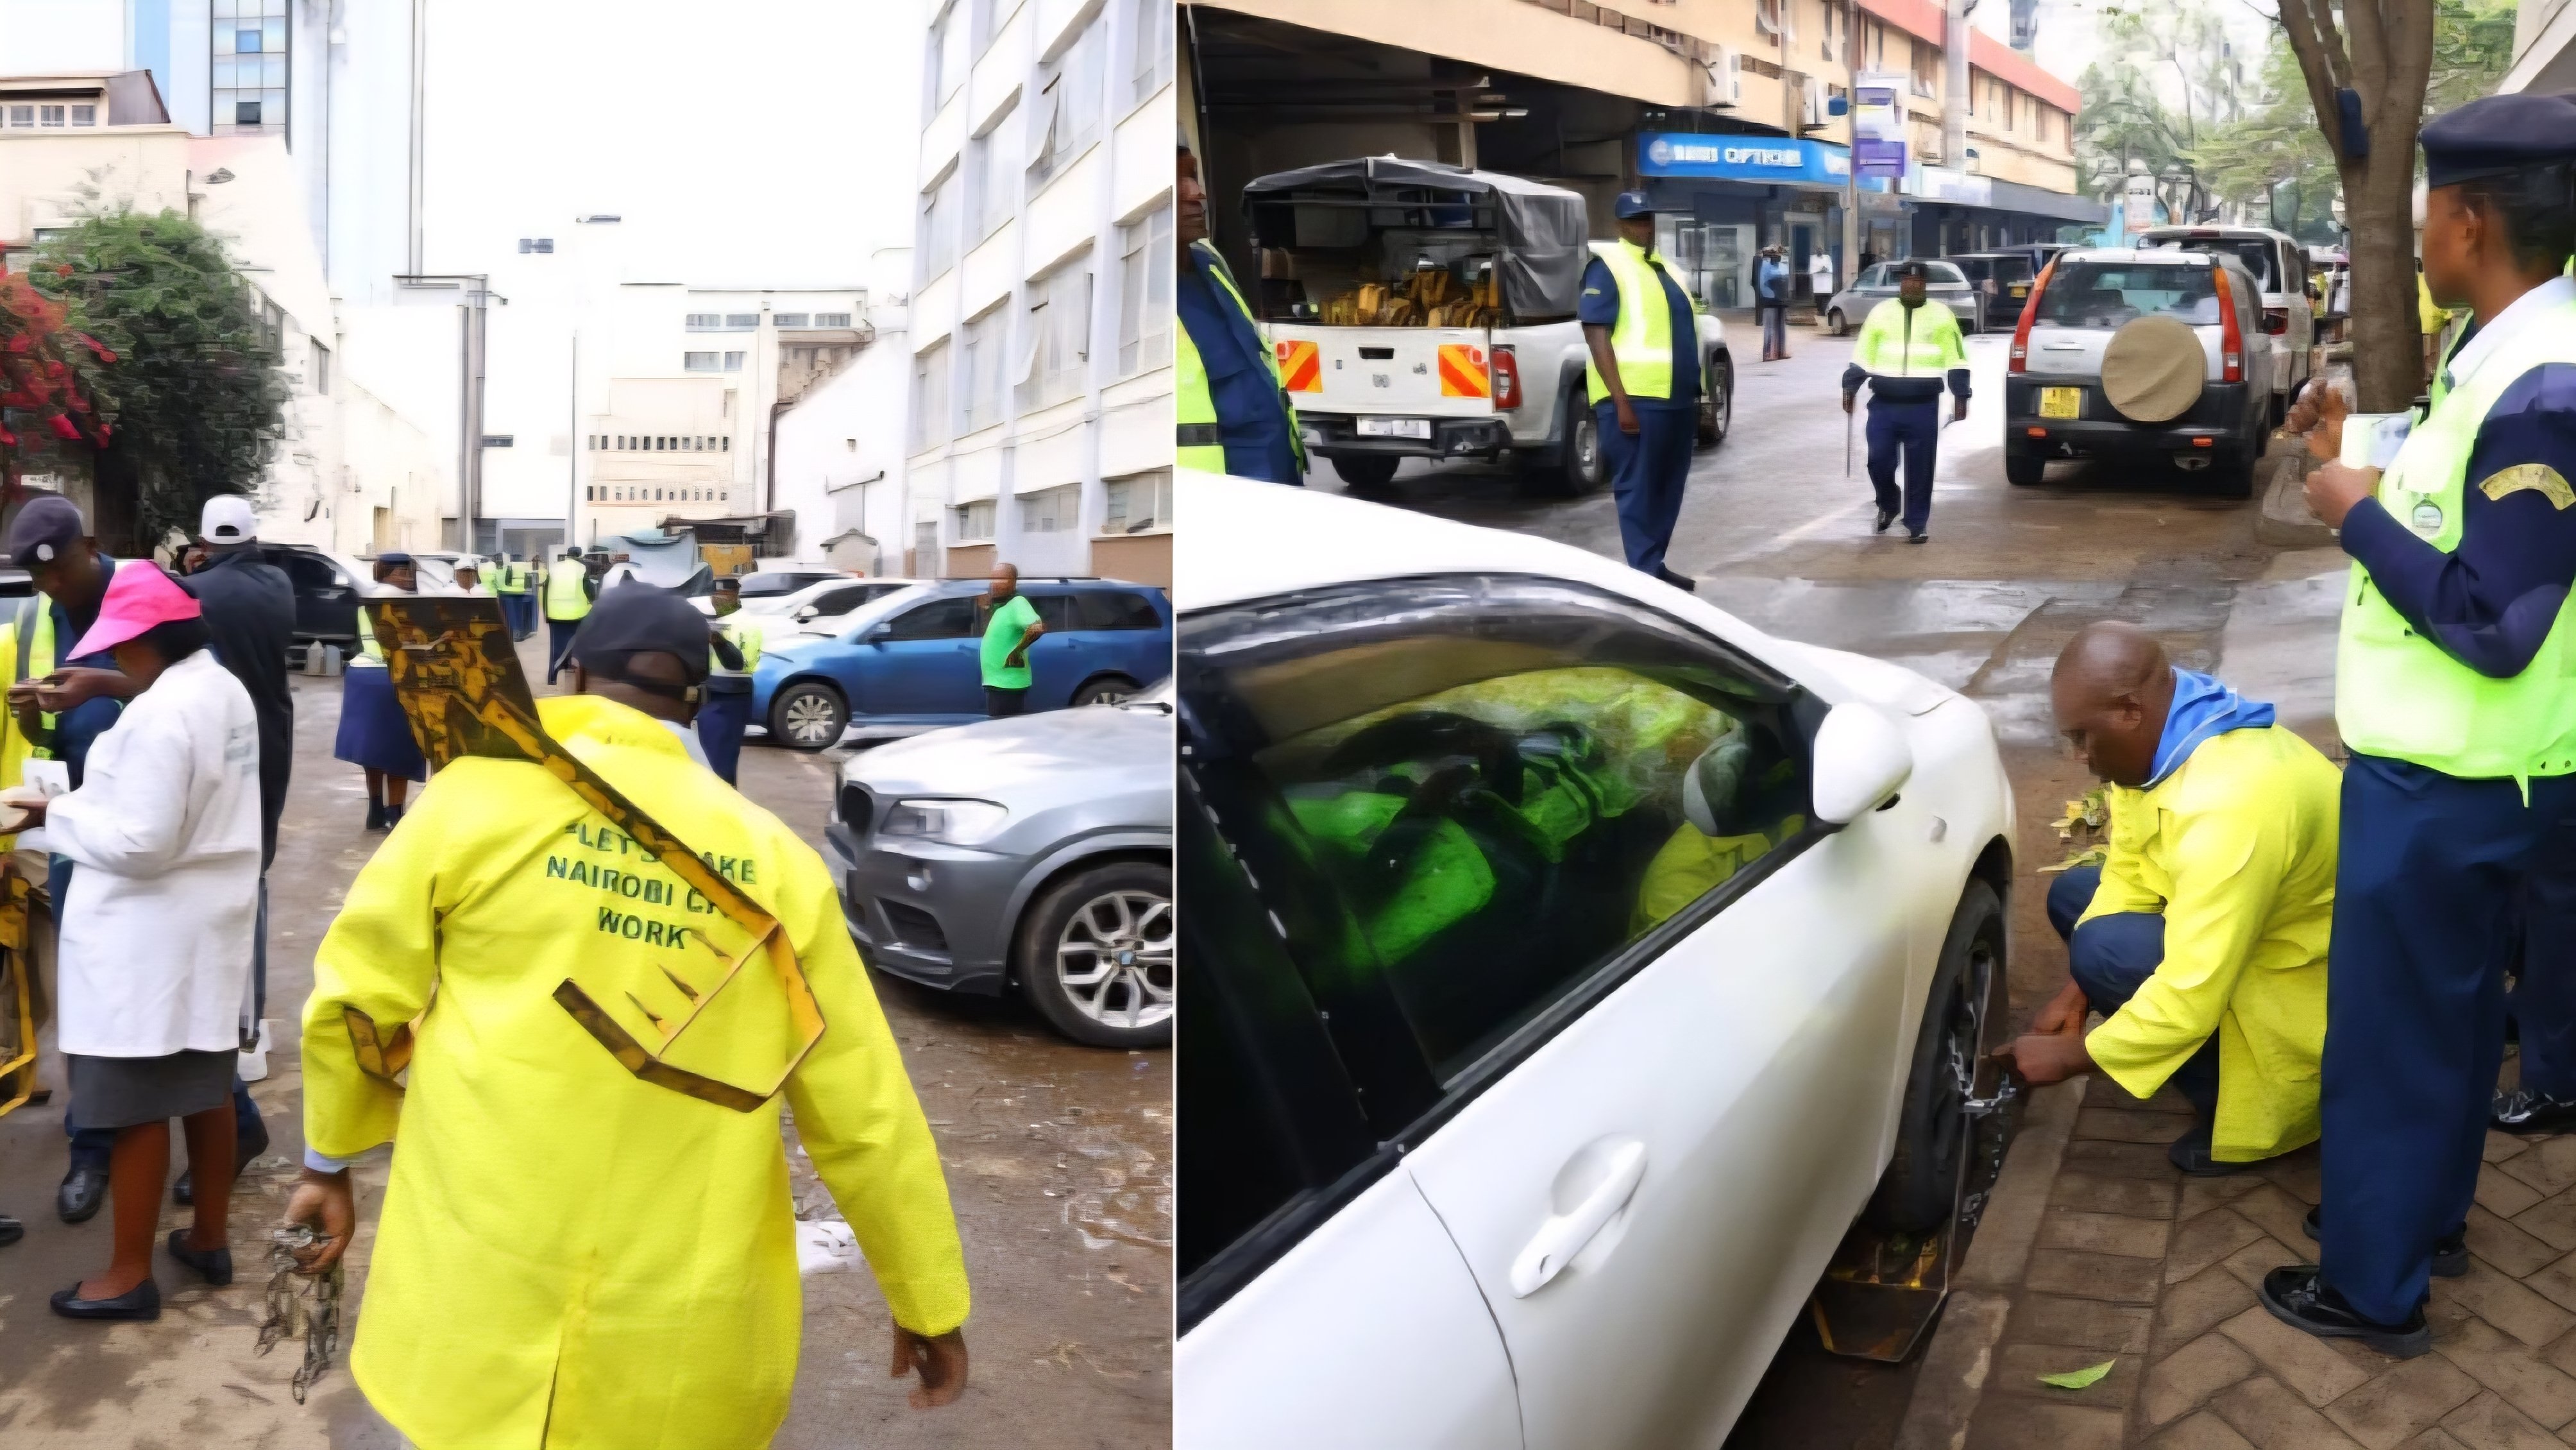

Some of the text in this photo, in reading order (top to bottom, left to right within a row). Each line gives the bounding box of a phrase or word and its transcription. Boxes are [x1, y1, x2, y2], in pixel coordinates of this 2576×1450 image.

[546, 855, 673, 907] NAIROBI
[701, 851, 757, 885] AKE
[598, 906, 686, 950] WORK
